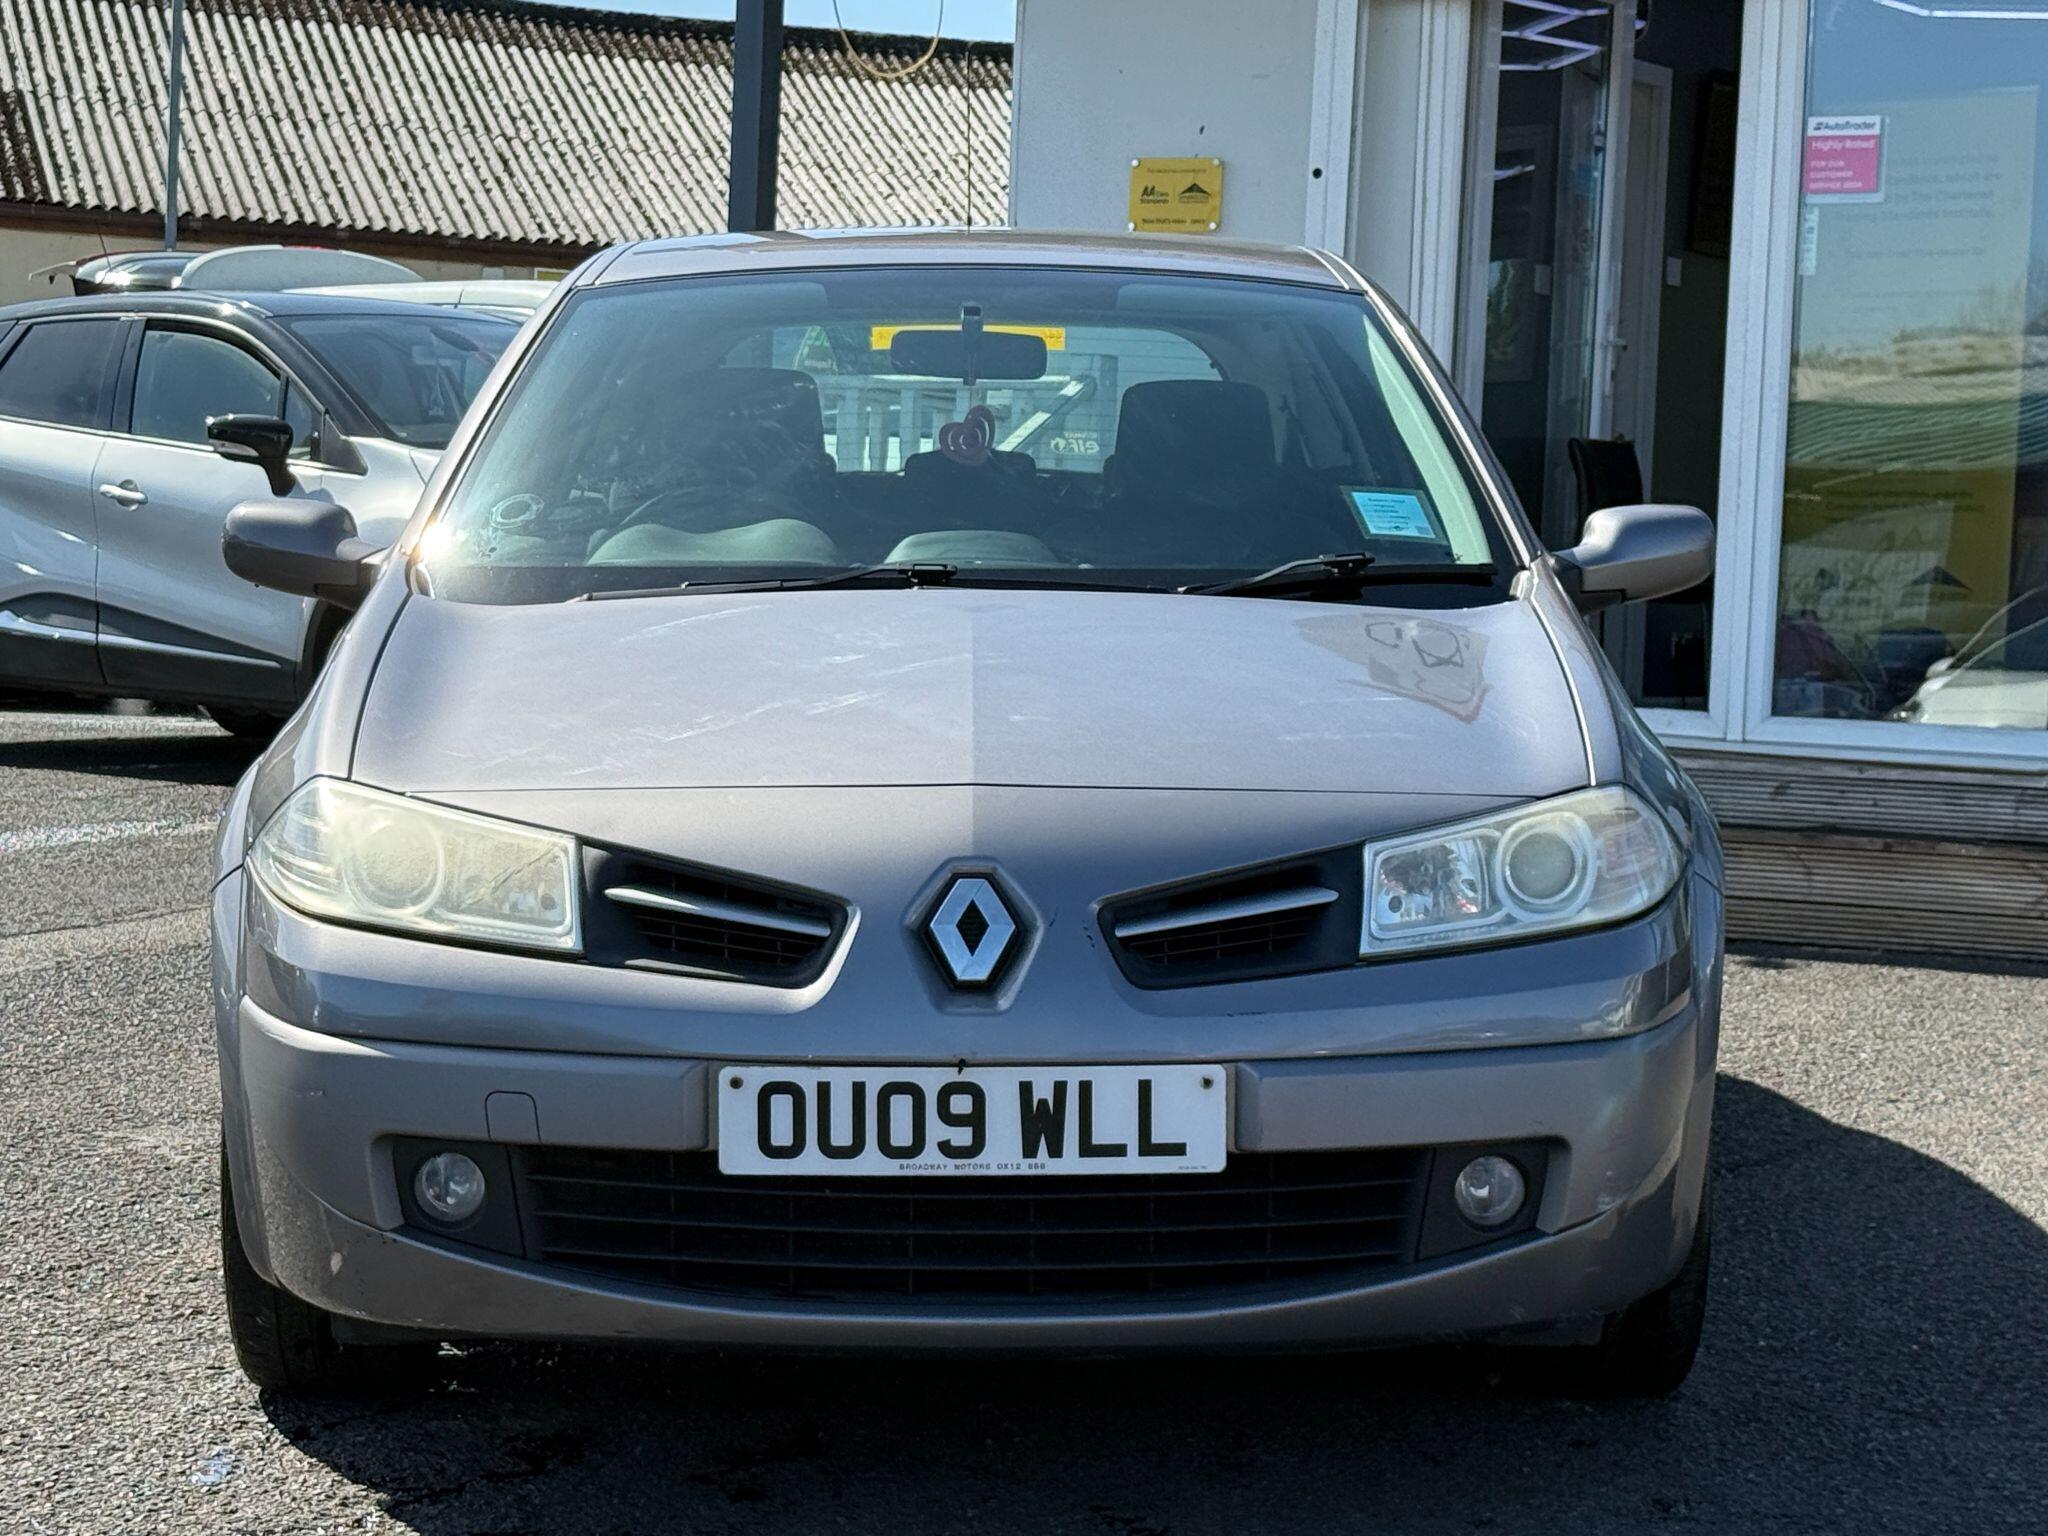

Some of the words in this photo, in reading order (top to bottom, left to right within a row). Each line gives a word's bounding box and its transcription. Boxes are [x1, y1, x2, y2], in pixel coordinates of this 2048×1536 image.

[757, 1081, 987, 1160] OU09
[1018, 1079, 1188, 1159] WLL
[899, 1163, 948, 1171] BROADWAY
[996, 1162, 1022, 1170] OX12
